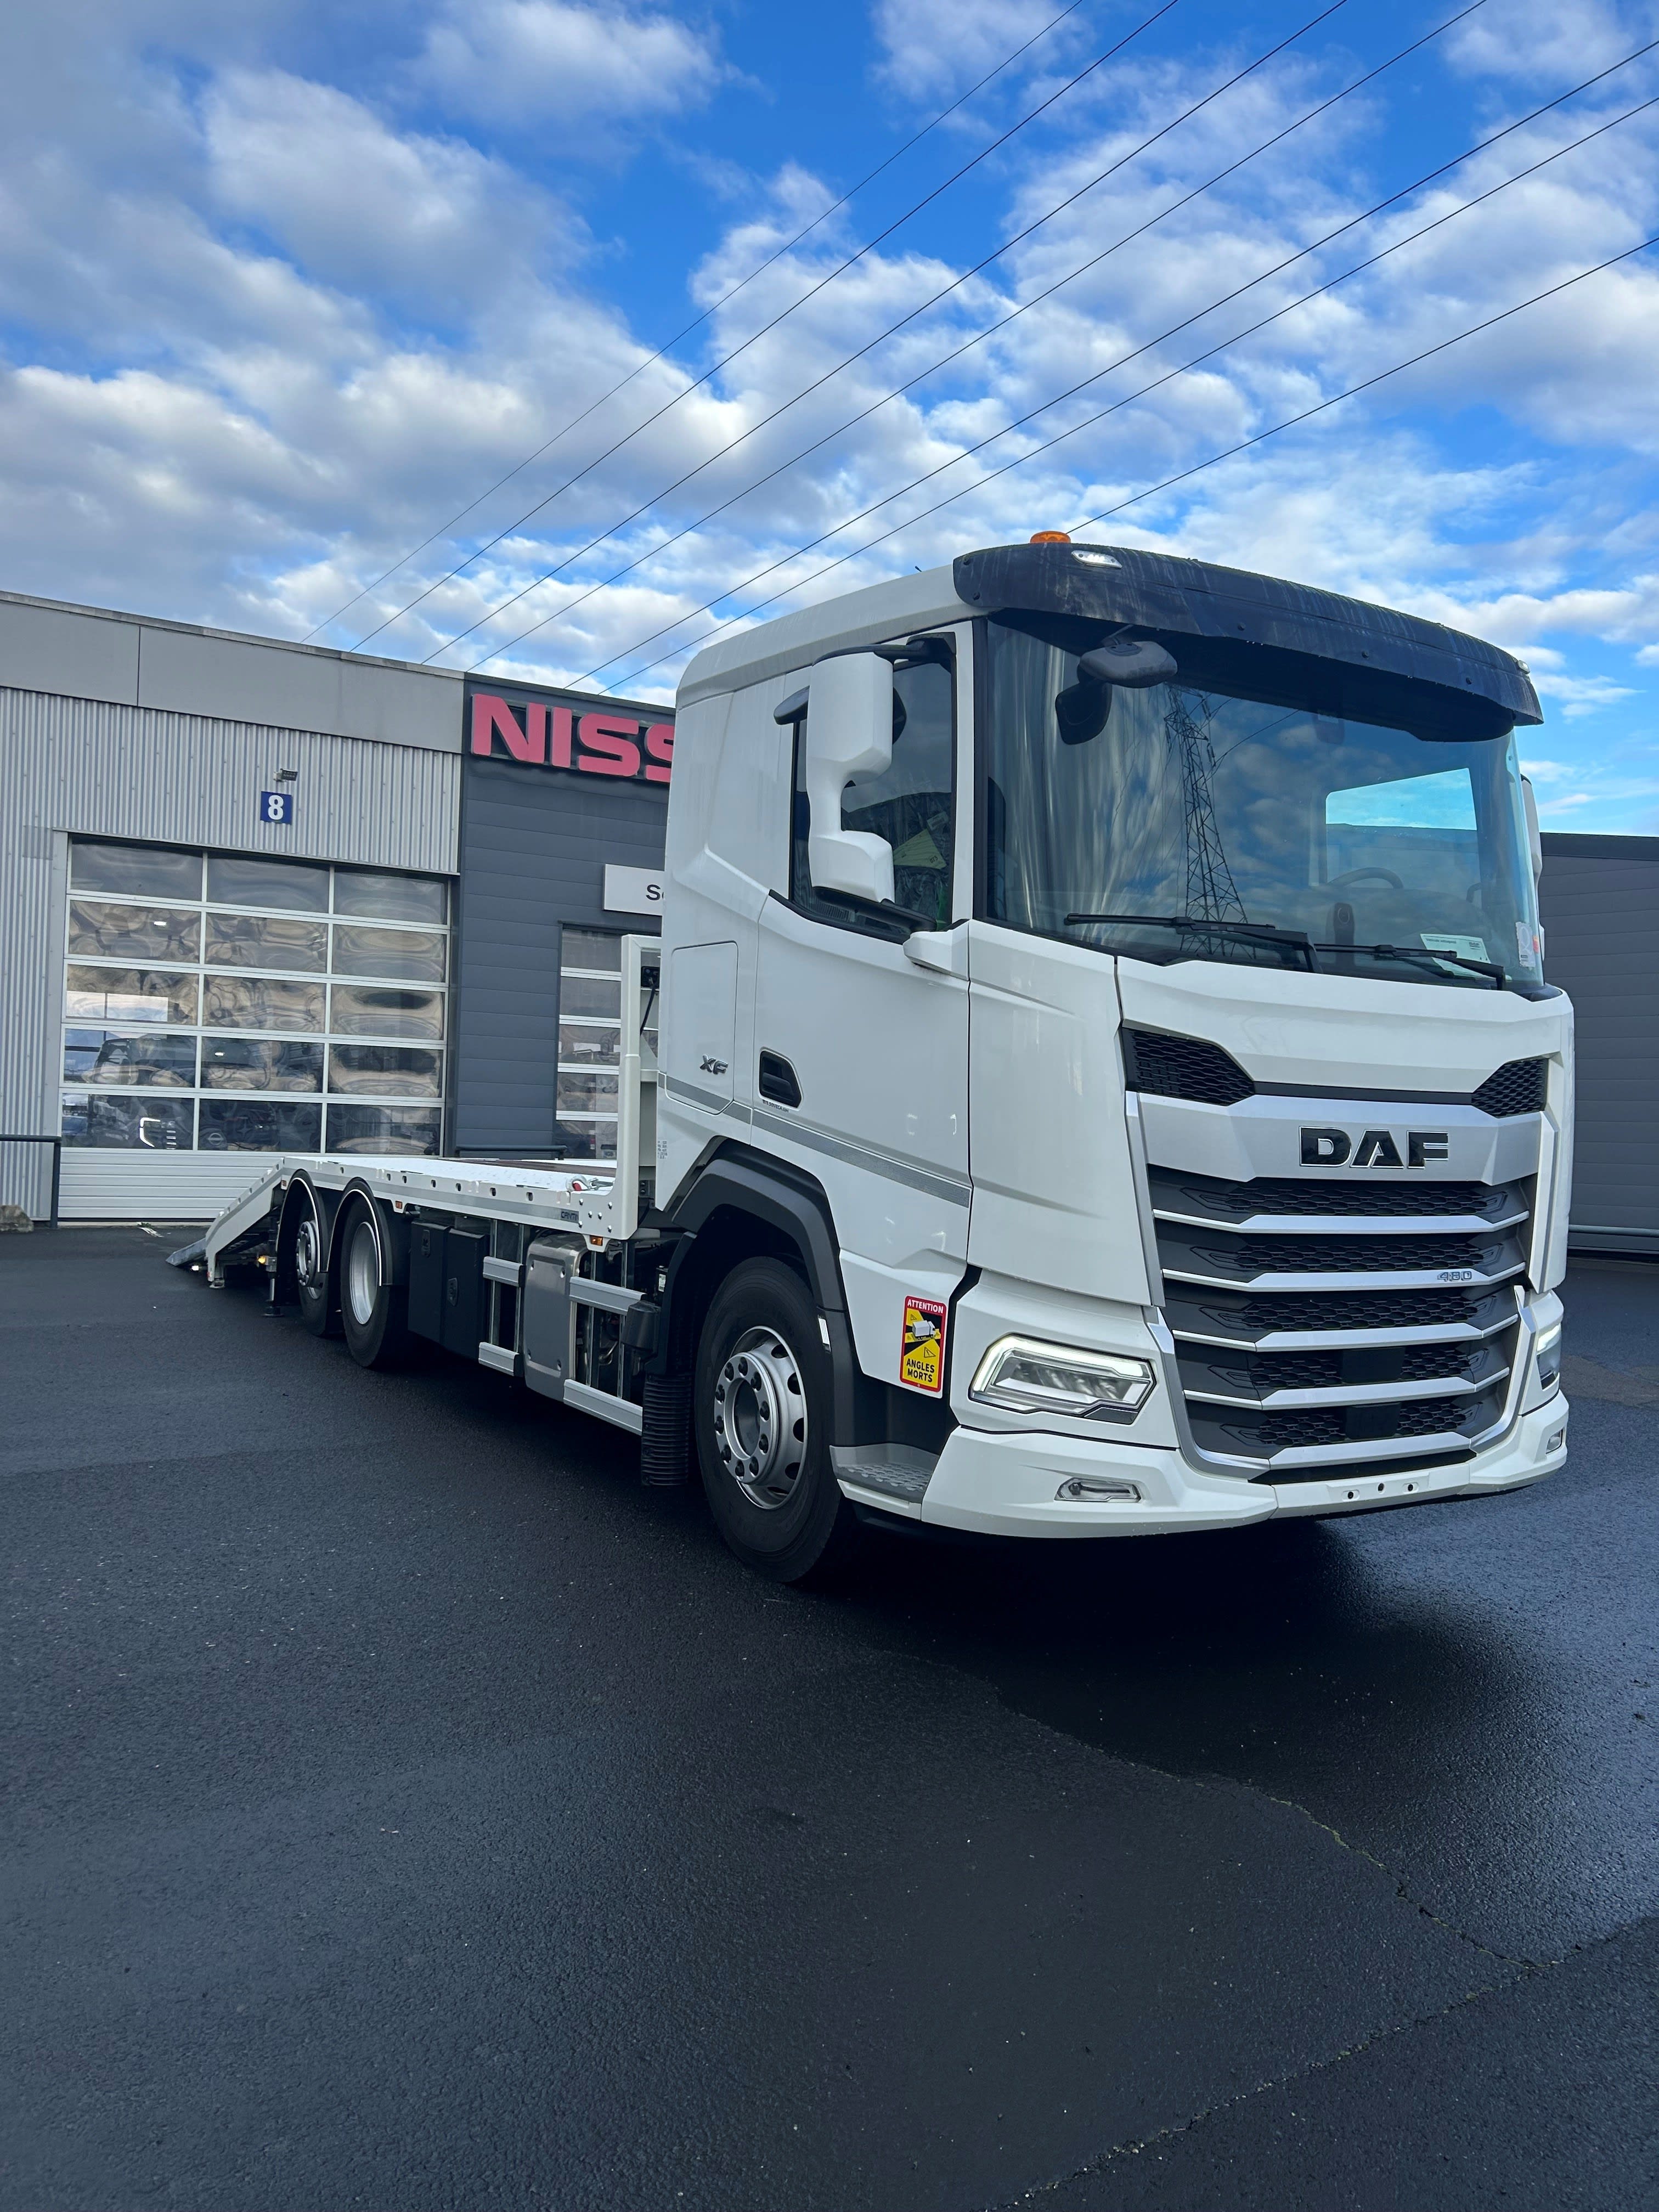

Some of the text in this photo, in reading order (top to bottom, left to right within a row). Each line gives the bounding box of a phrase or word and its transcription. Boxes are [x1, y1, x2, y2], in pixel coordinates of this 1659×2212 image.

[268, 794, 284, 820] 8
[646, 884, 664, 901] S
[699, 1054, 729, 1075] XF
[1299, 1126, 1448, 1169] DAF
[1437, 1271, 1472, 1282] 480
[907, 1299, 944, 1314] ATTENTION
[906, 1358, 935, 1373] ANGLES
[907, 1368, 933, 1383] MORTS
